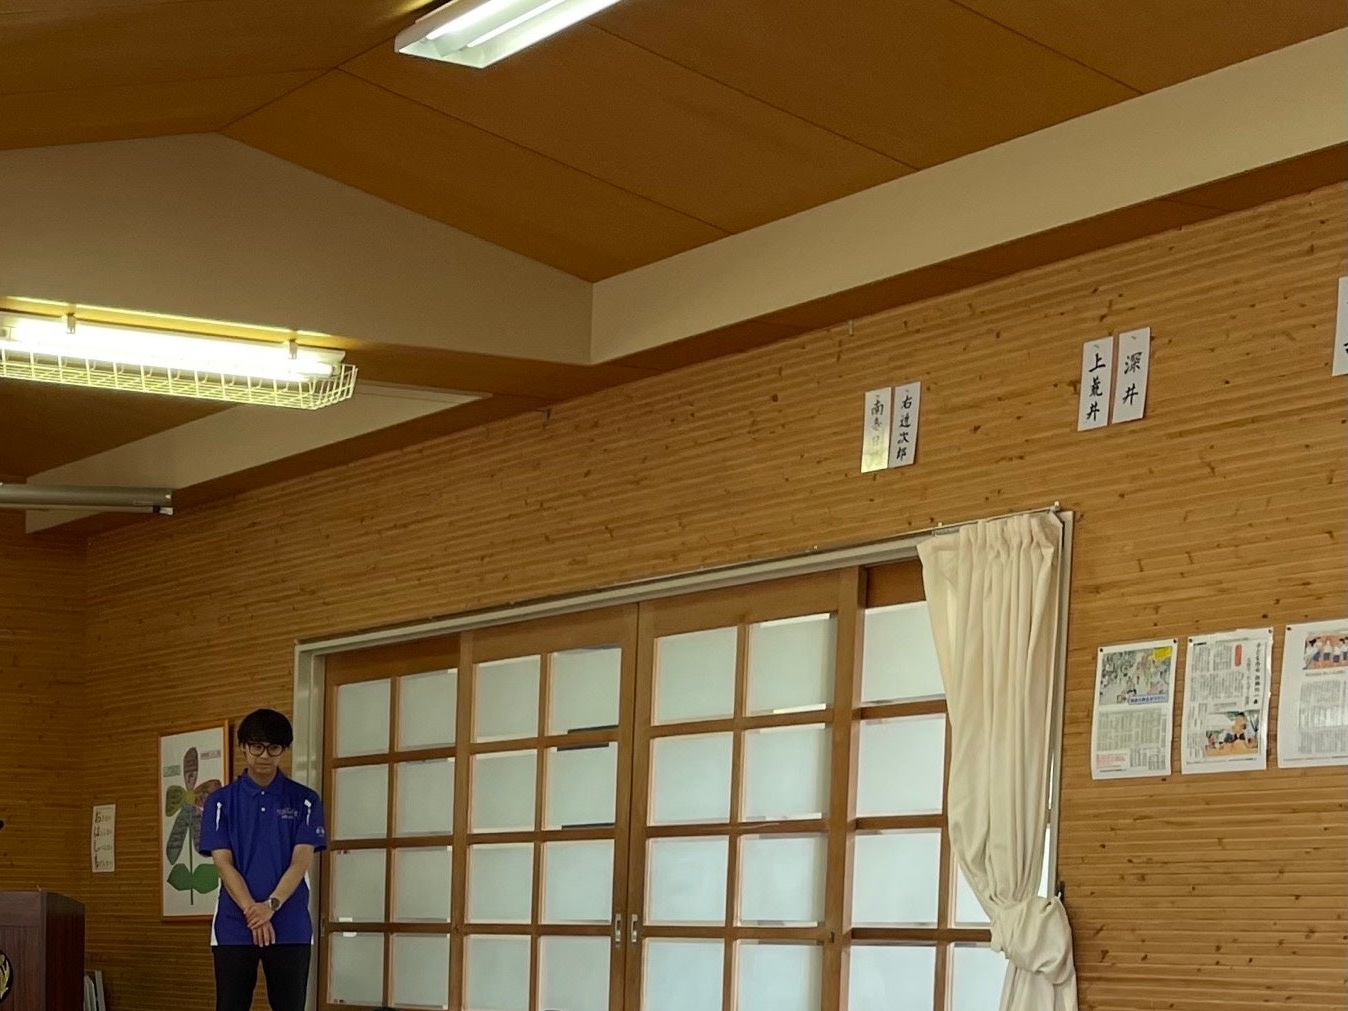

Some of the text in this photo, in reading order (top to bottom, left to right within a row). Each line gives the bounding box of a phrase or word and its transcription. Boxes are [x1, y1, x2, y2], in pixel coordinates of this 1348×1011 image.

[1085, 352, 1107, 422] 上荒井
[1122, 351, 1143, 406] 深井
